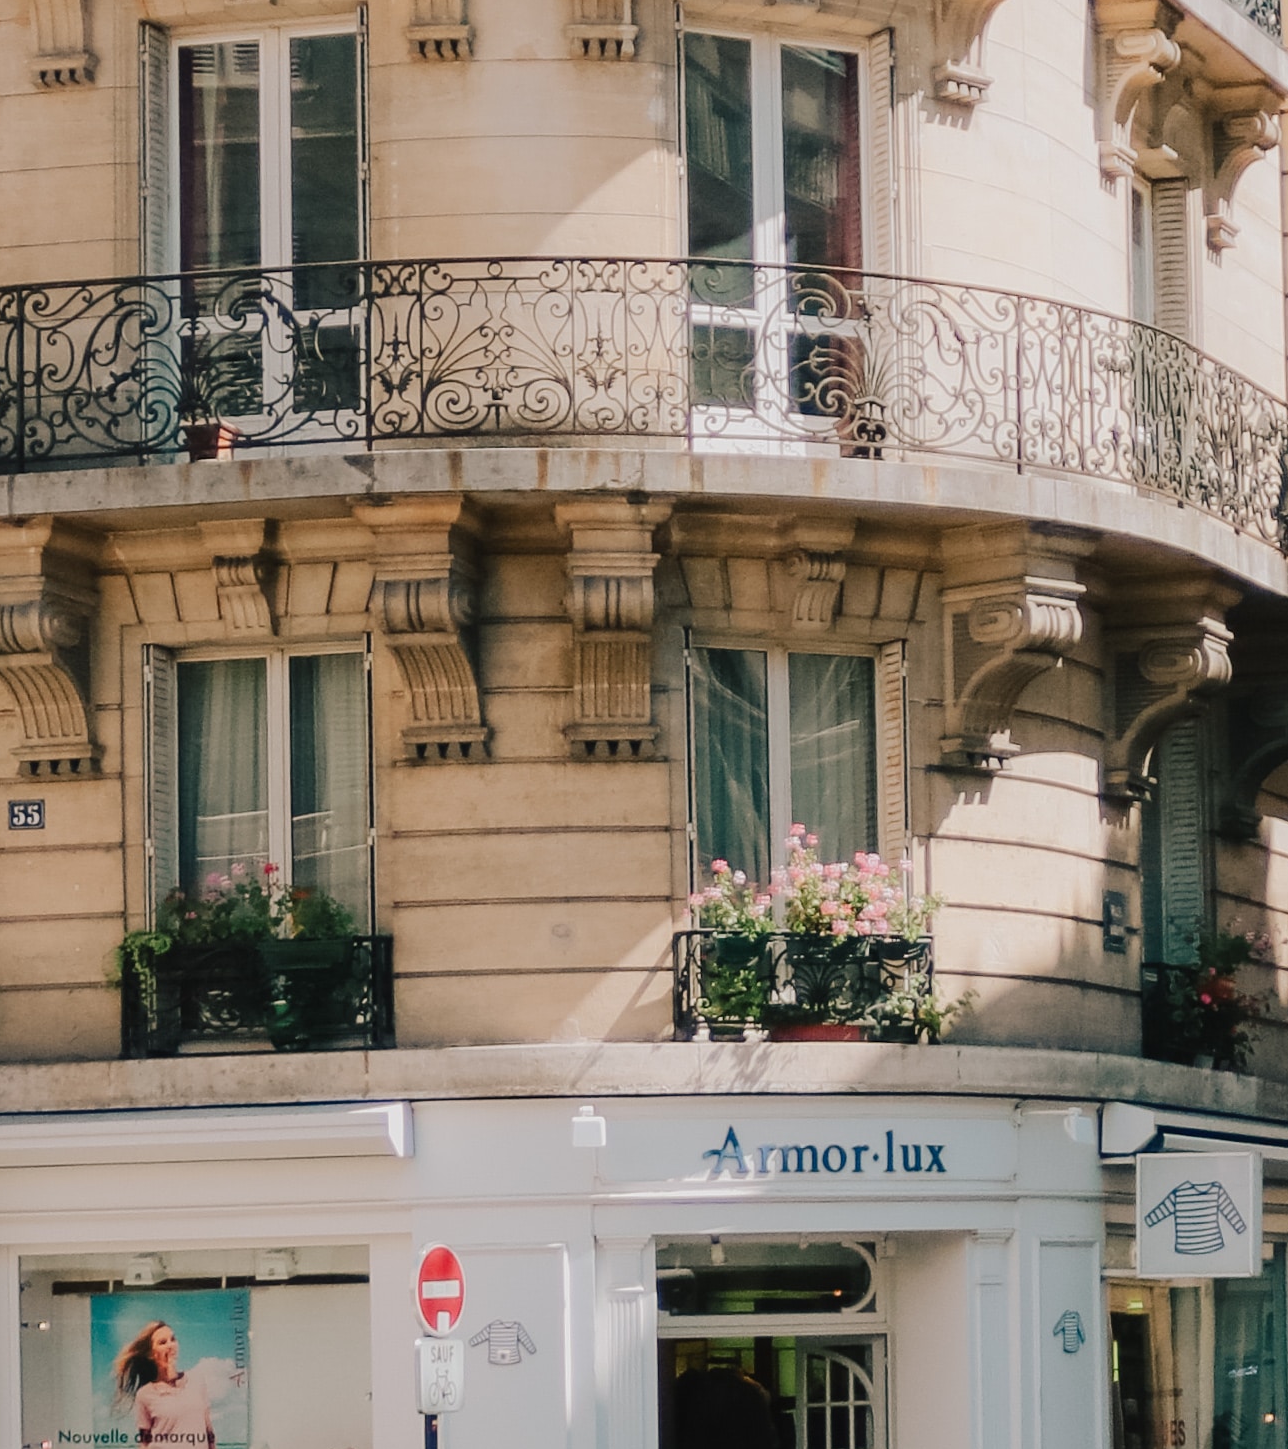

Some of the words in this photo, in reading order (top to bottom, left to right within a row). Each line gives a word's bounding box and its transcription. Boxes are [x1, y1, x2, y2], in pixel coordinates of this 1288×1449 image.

[12, 804, 40, 826] 55
[430, 1345, 455, 1364] SAUF
[58, 1429, 129, 1444] Nouvelle
